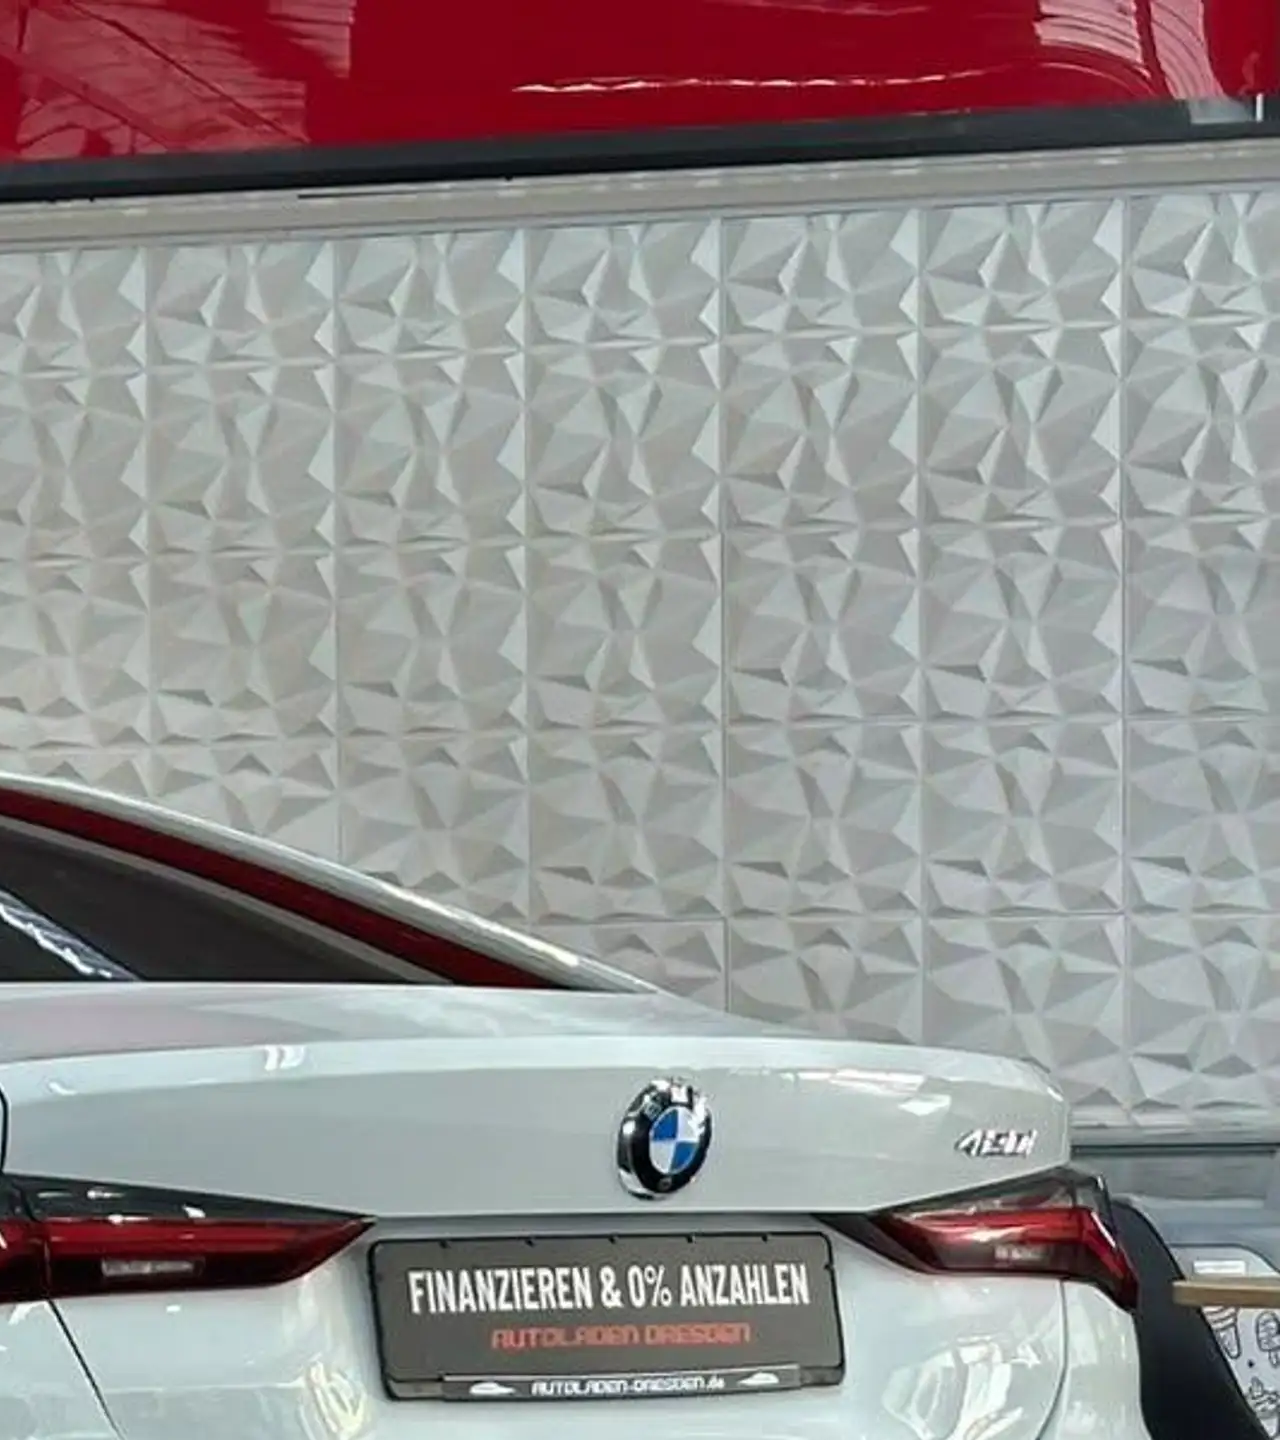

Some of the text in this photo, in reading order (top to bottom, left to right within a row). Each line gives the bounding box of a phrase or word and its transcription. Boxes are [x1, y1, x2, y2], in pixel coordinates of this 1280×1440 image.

[407, 1262, 811, 1314] FINANZIEREN & 0% ANZAHLEN
